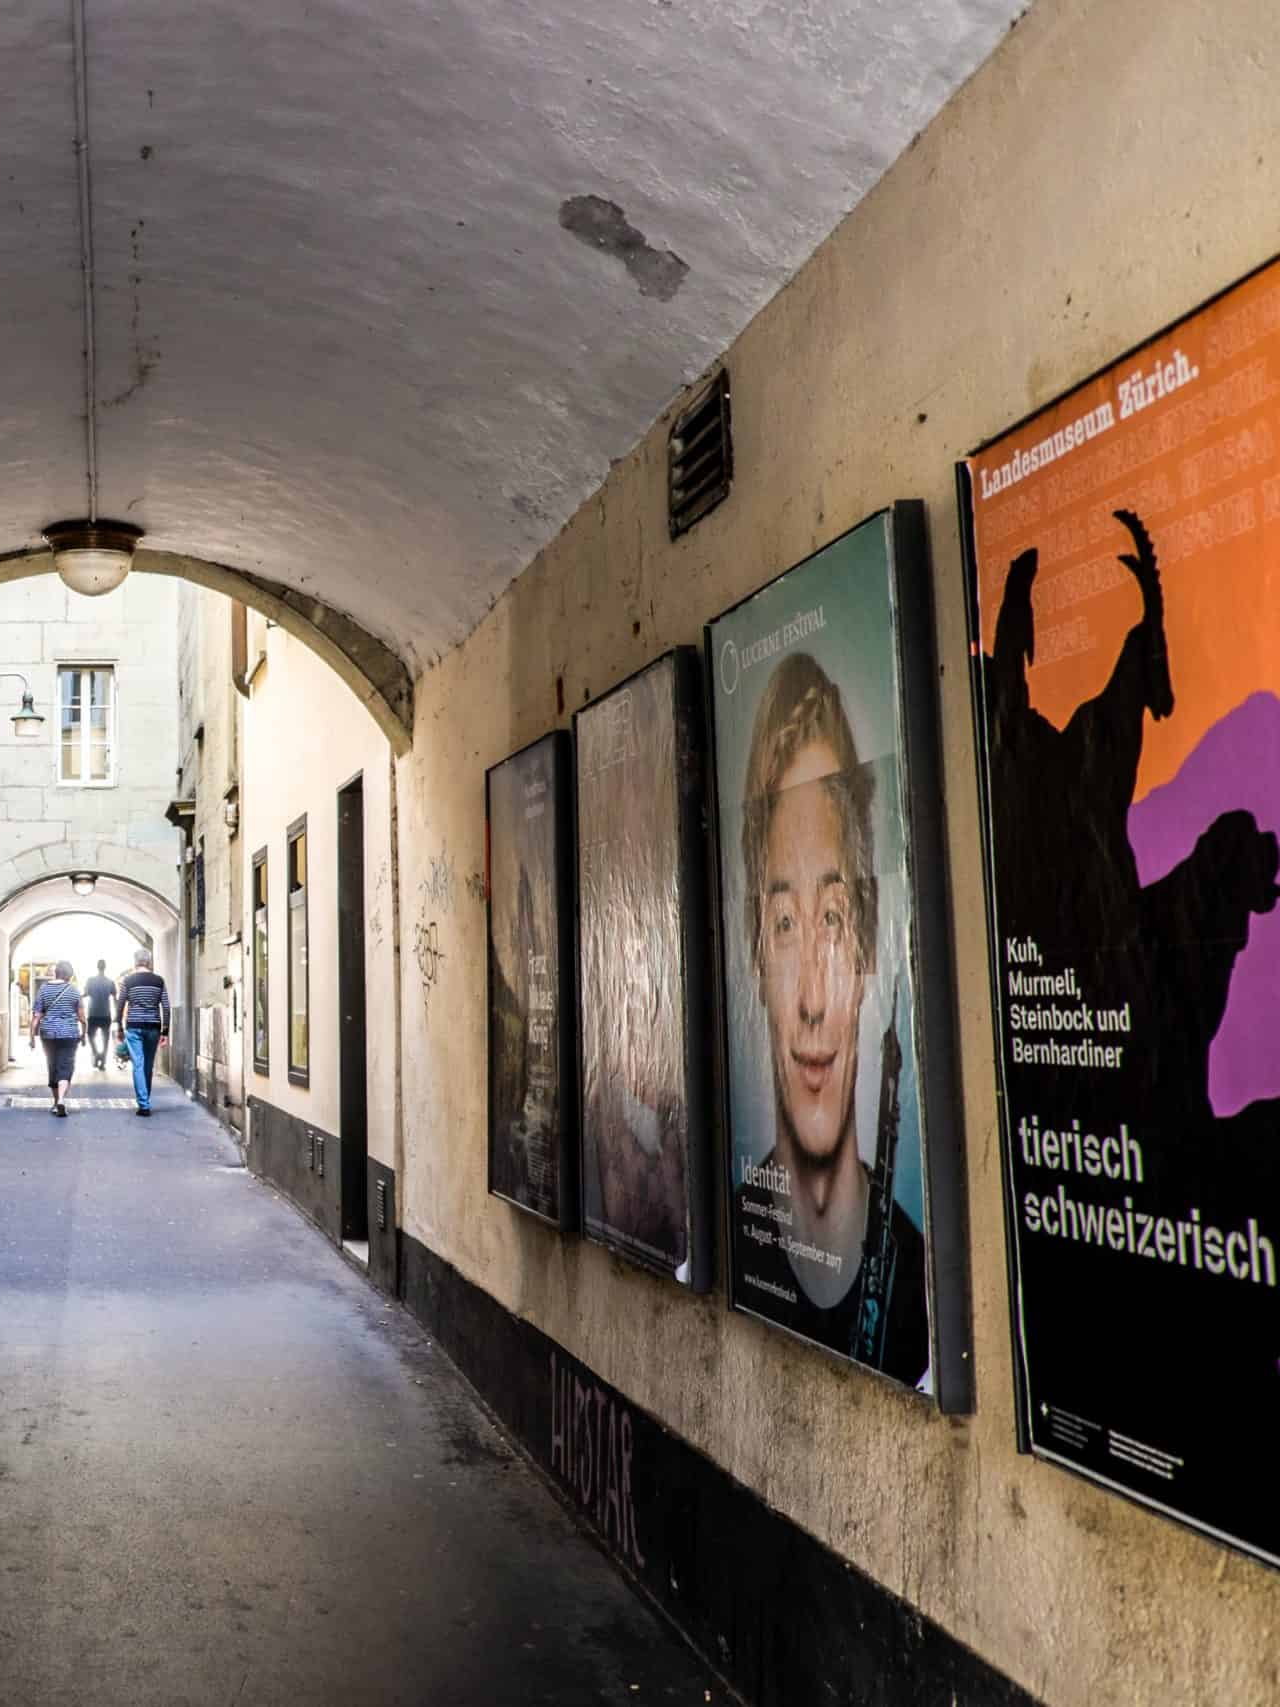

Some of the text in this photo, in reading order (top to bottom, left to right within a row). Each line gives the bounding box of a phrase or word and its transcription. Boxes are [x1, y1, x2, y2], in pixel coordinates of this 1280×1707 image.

[980, 349, 1200, 500] Landesmuseum Zürich.
[1006, 936, 1043, 968] Kuh,
[1008, 968, 1082, 1000] Murmeli,
[1010, 1003, 1131, 1033] Steinbock und
[1012, 1038, 1123, 1068] Bernhardiner
[1018, 1115, 1144, 1183] tierisch
[740, 1155, 792, 1196] Identität
[1024, 1185, 1277, 1287] schweizerisch
